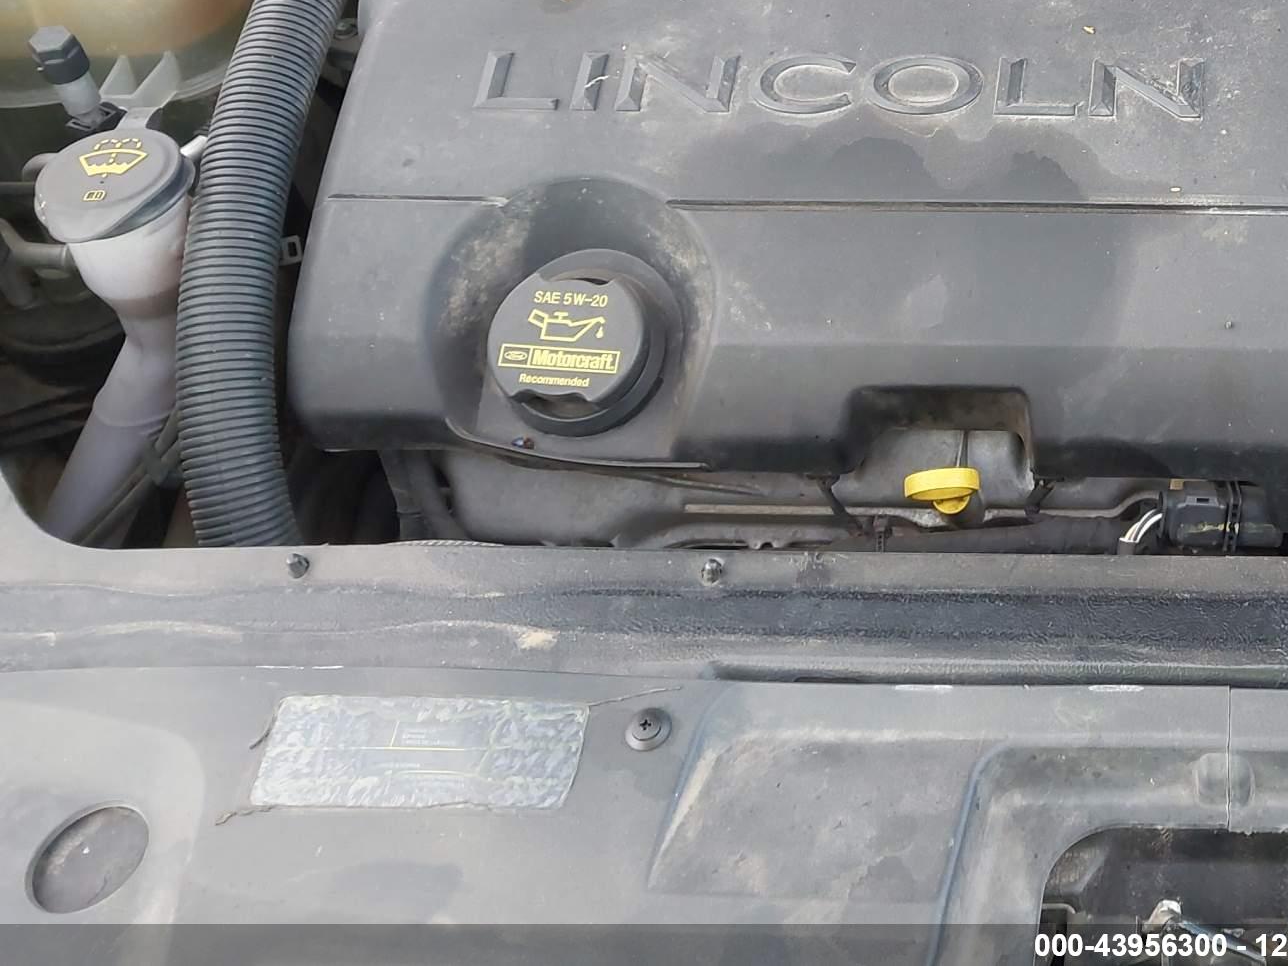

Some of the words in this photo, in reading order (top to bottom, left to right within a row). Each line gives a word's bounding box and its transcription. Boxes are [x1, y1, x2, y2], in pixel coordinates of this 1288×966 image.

[471, 49, 1205, 121] LINCOLN
[533, 290, 561, 305] SAE
[563, 292, 608, 308] 5W-20
[519, 373, 590, 387] Recommended
